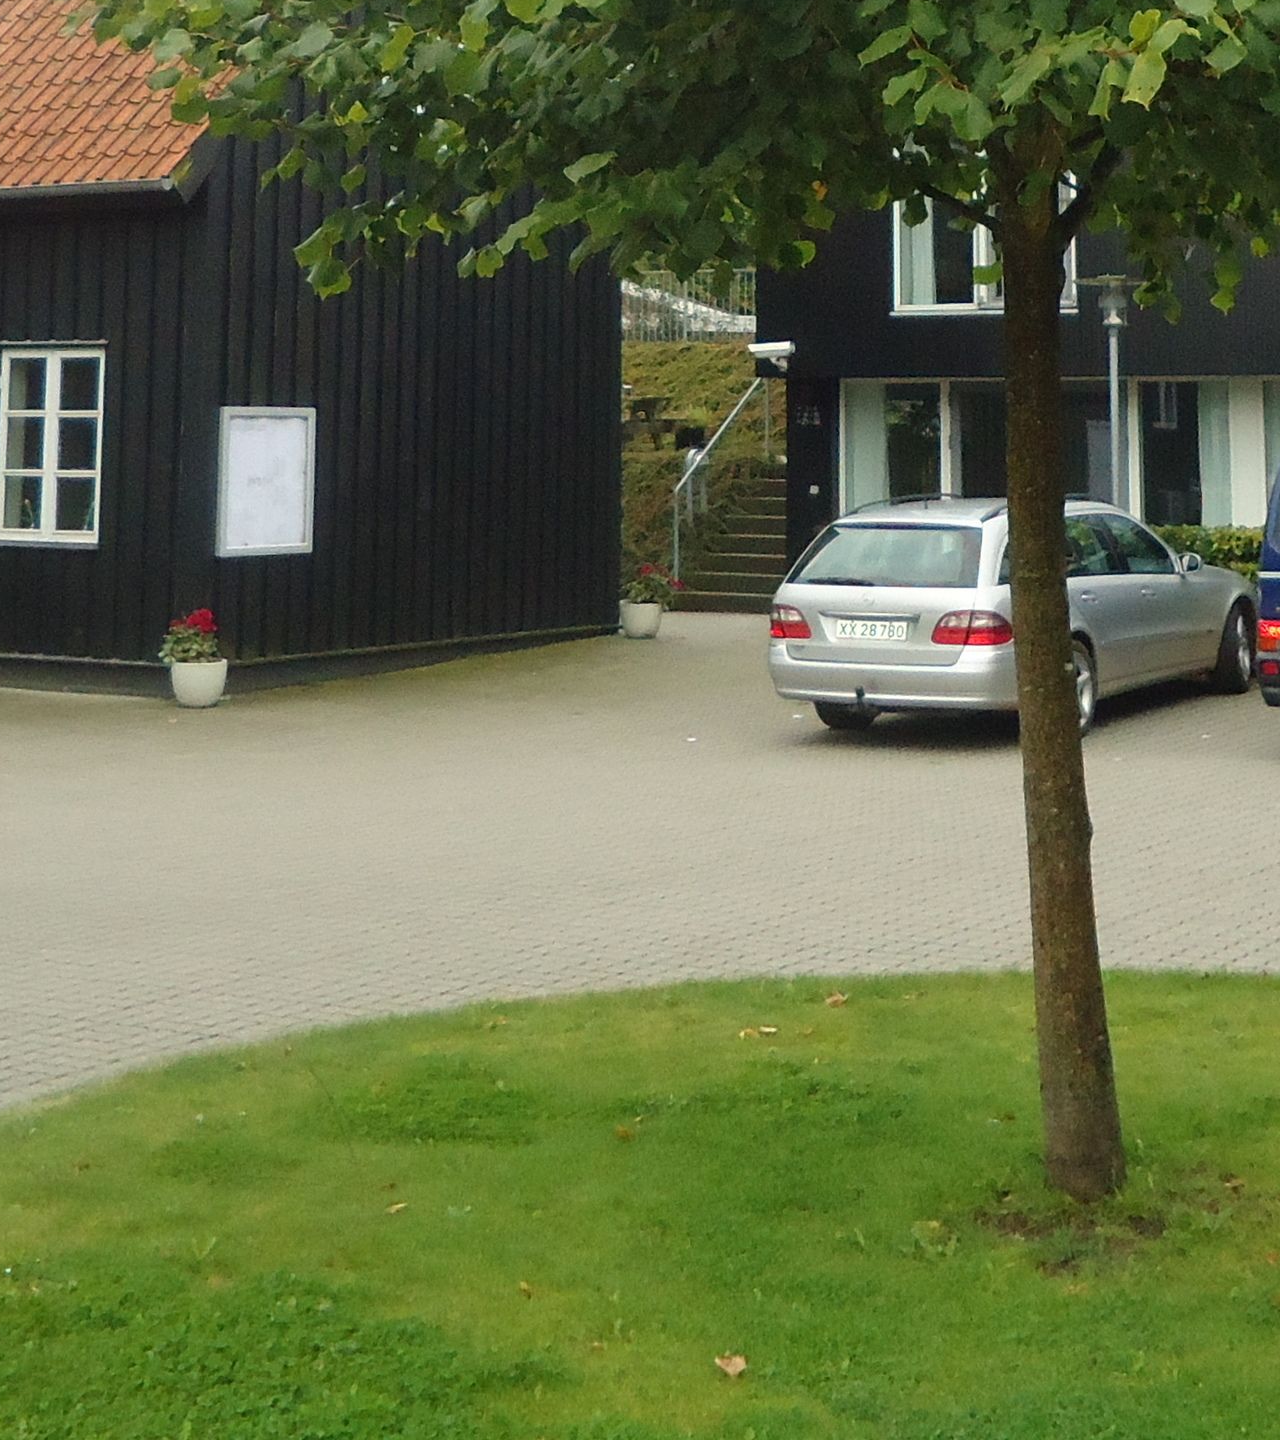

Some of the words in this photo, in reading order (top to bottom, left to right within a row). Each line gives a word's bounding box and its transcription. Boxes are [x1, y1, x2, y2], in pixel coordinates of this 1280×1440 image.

[840, 623, 857, 636] XX
[860, 623, 877, 637] 28
[880, 624, 904, 638] 780
